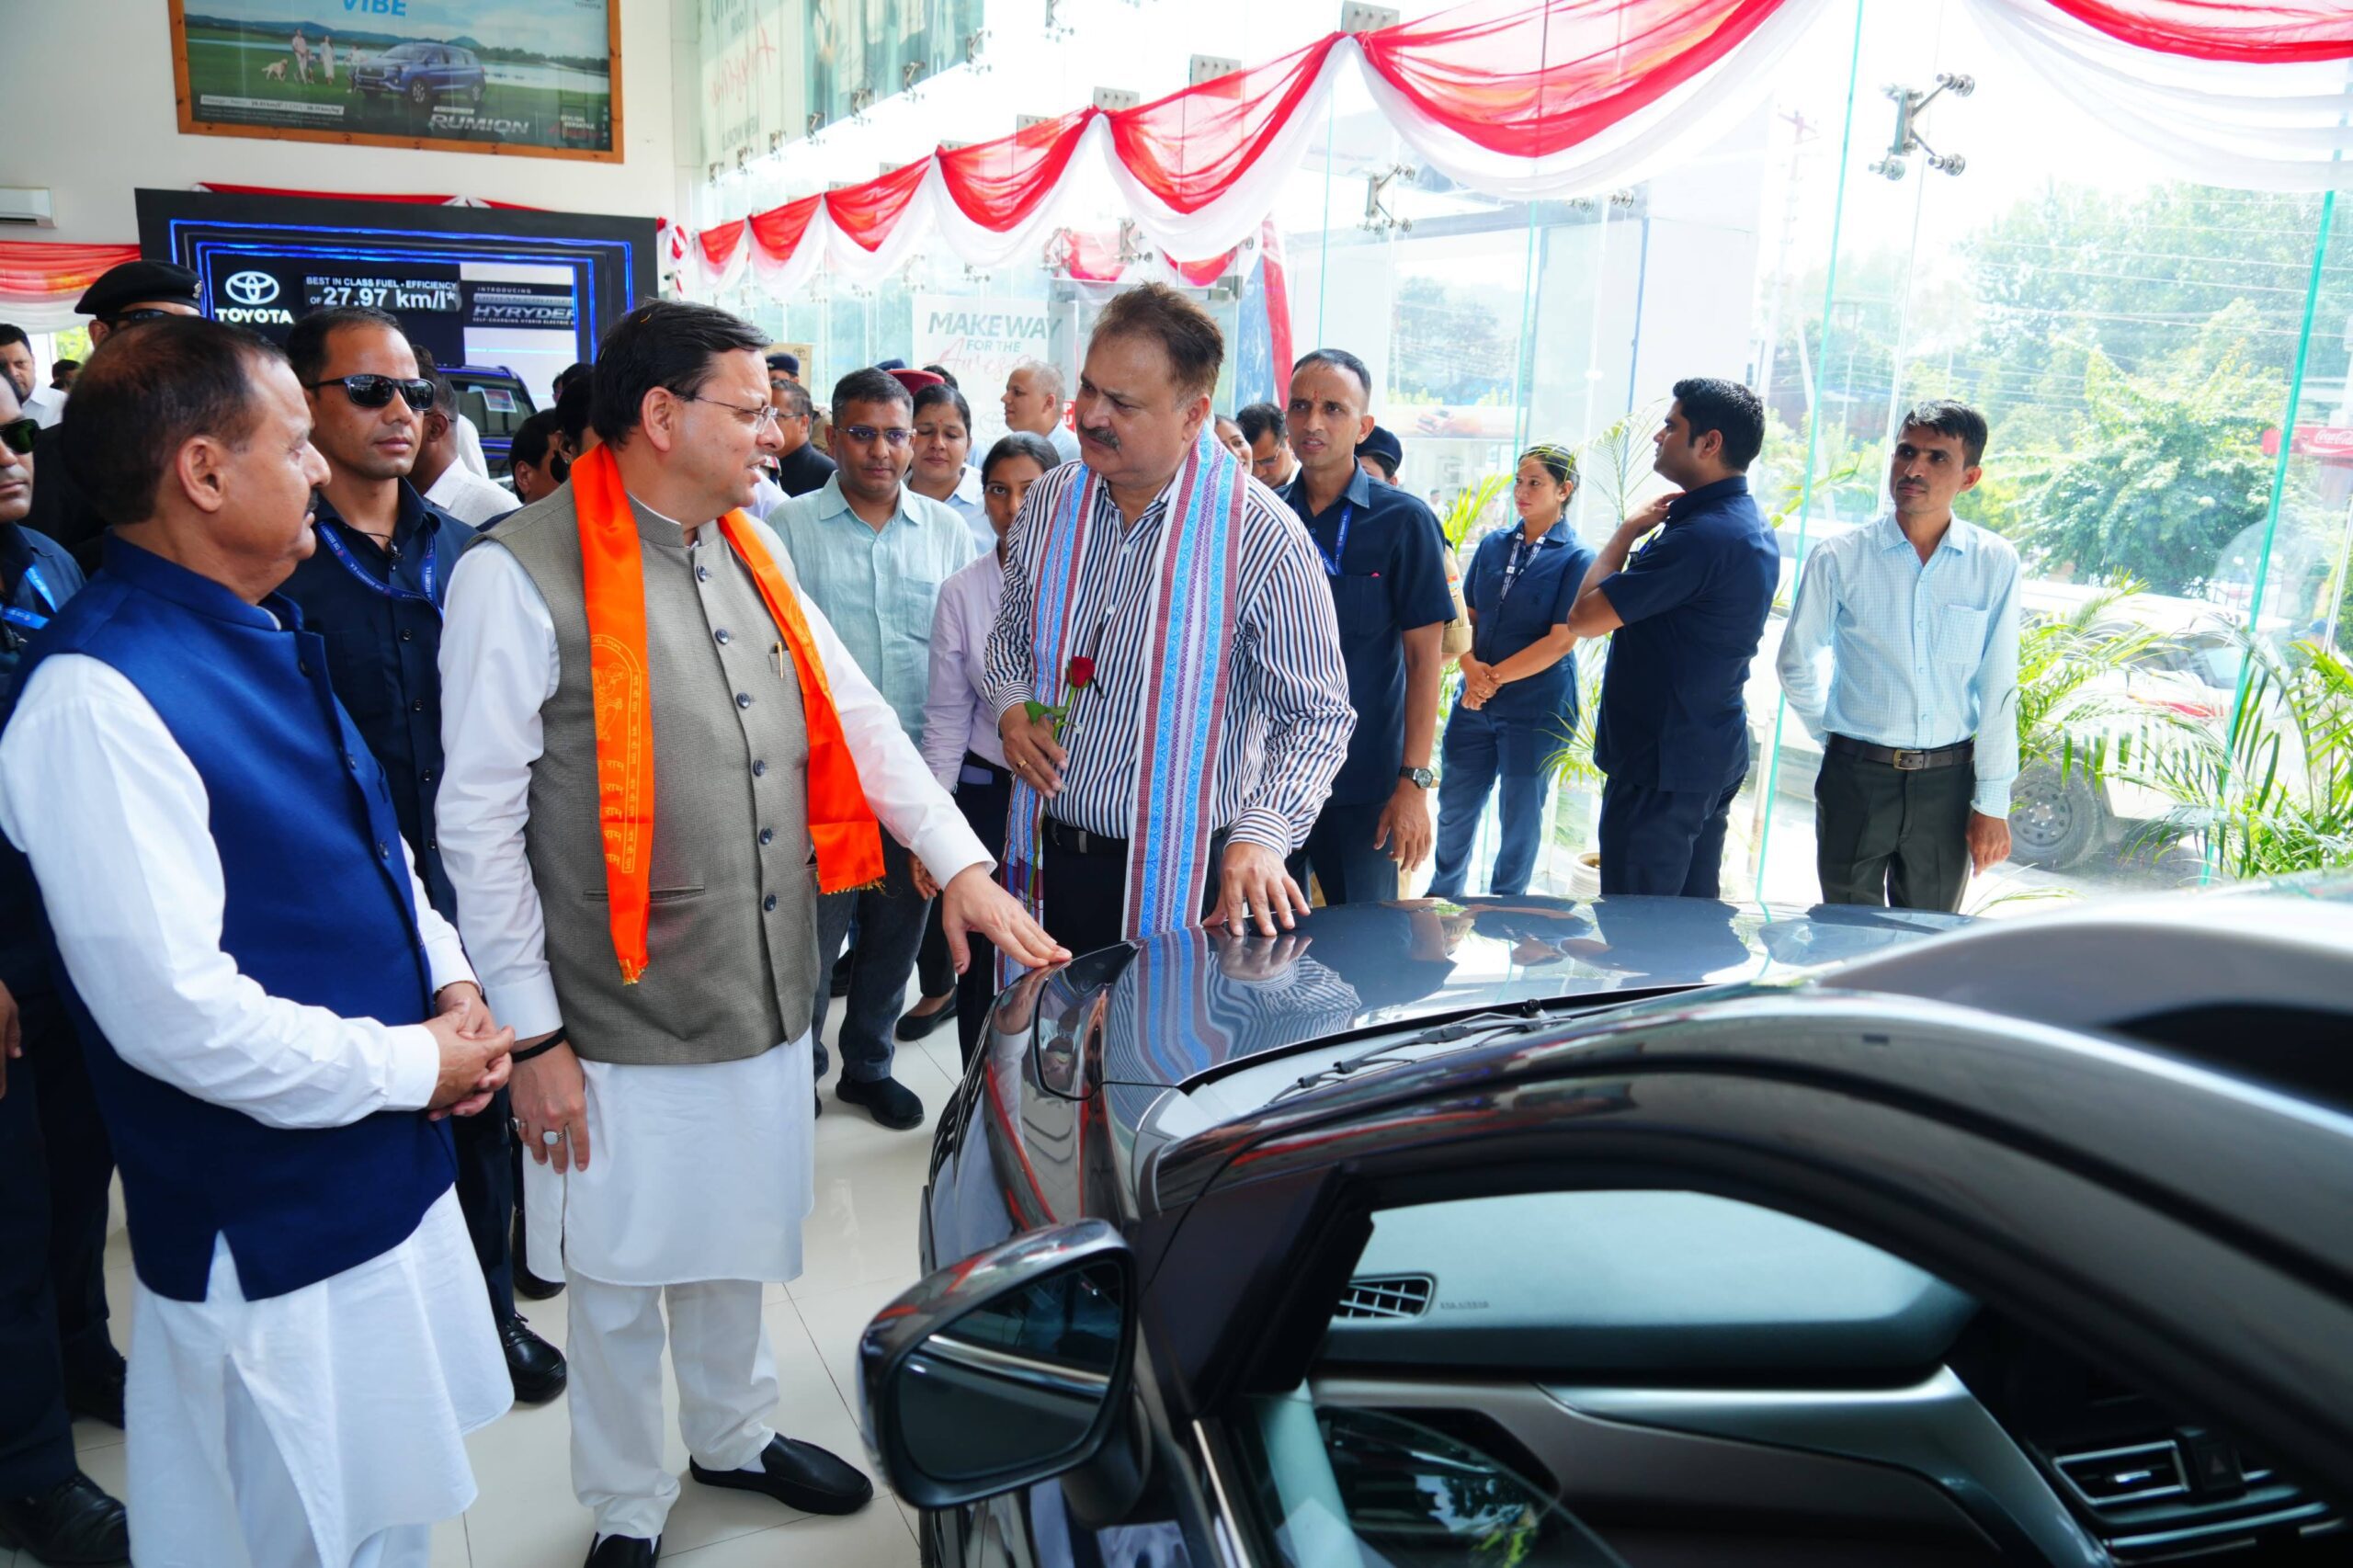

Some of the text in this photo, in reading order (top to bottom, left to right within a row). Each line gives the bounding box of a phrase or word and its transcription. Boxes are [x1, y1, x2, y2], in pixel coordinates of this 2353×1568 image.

[429, 113, 529, 135] RUMION
[306, 277, 331, 286] BEST
[333, 278, 342, 286] IN
[344, 278, 374, 288] CLASS
[376, 278, 401, 289] FUEL
[405, 279, 457, 290] EFFICIENCY
[477, 286, 532, 294] INTRODUCING
[310, 296, 322, 305] OF
[323, 286, 388, 308] 27.97
[215, 308, 294, 324] TOYOTA
[928, 311, 1063, 340] MAKE WAY
[966, 339, 1022, 353] FOR THE
